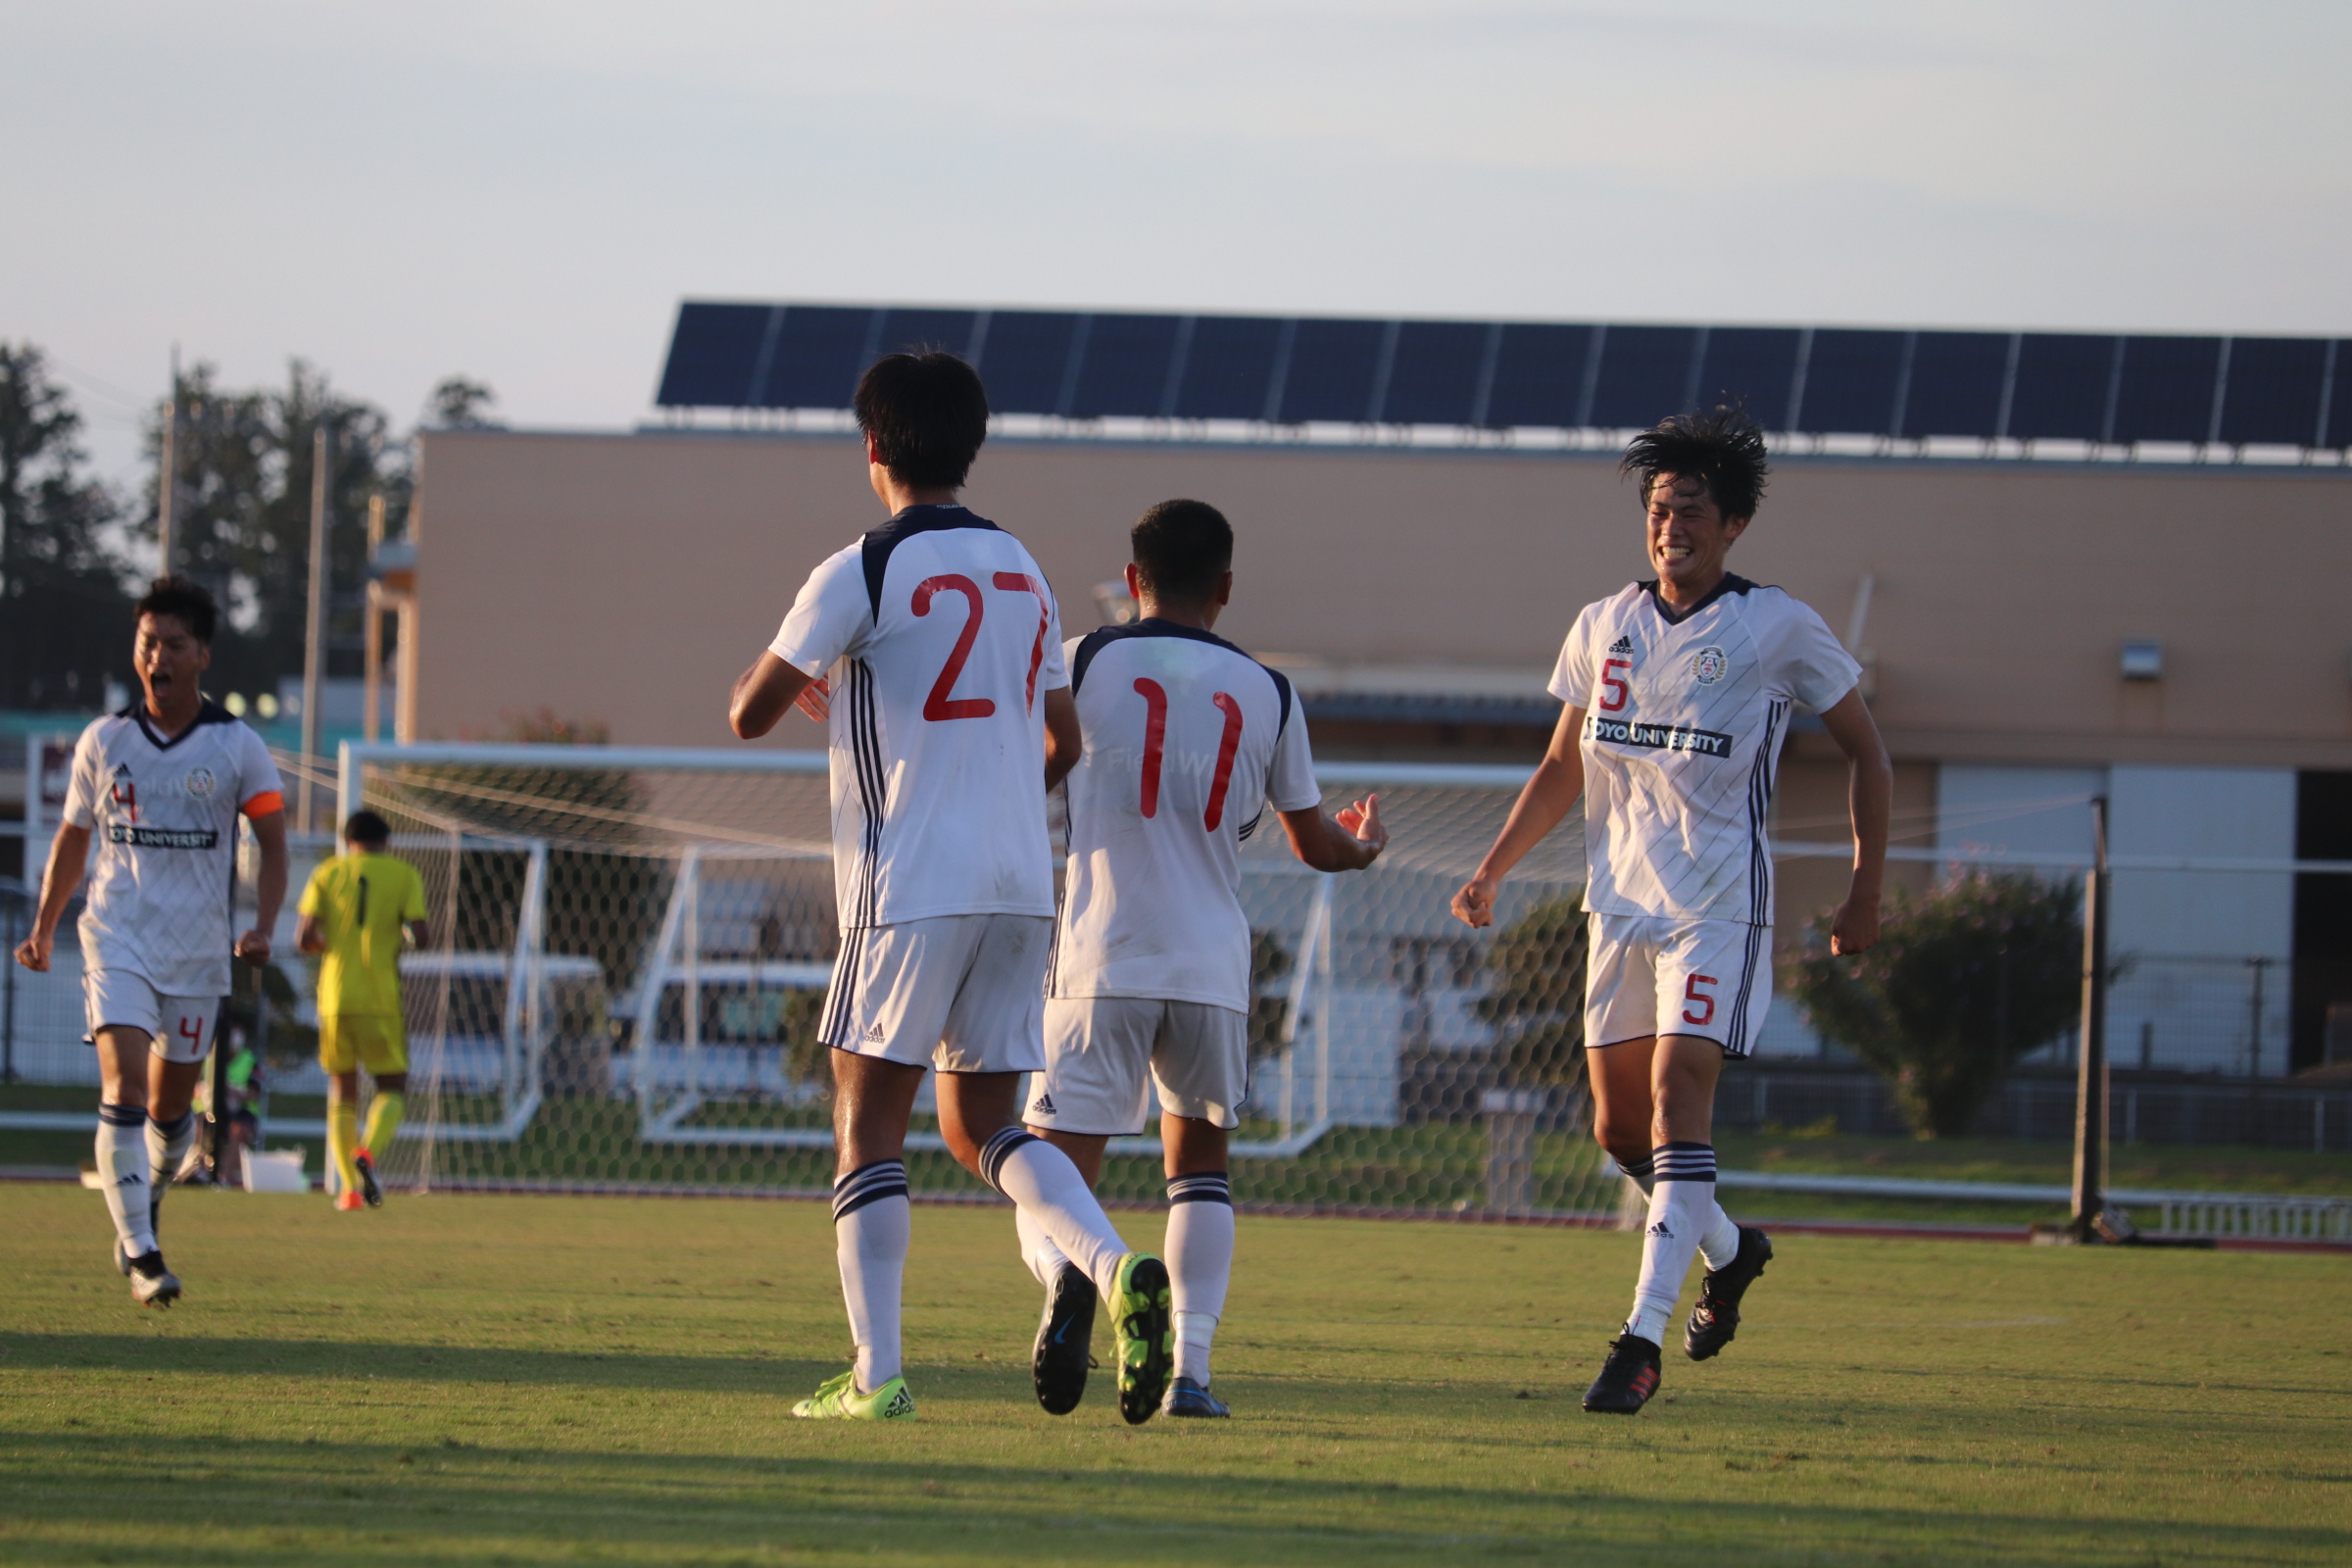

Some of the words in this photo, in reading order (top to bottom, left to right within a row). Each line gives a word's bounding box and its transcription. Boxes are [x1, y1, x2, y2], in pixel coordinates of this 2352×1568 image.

[911, 571, 1049, 722] 27
[1598, 659, 1632, 711] 5
[1133, 677, 1243, 832] 11
[1632, 727, 1725, 753] UNIVERSITY
[113, 782, 137, 823] 4
[138, 829, 213, 849] UNIVERSIT
[357, 875, 369, 928] 1
[1682, 974, 1718, 1026] 5
[179, 1015, 203, 1055] 4
